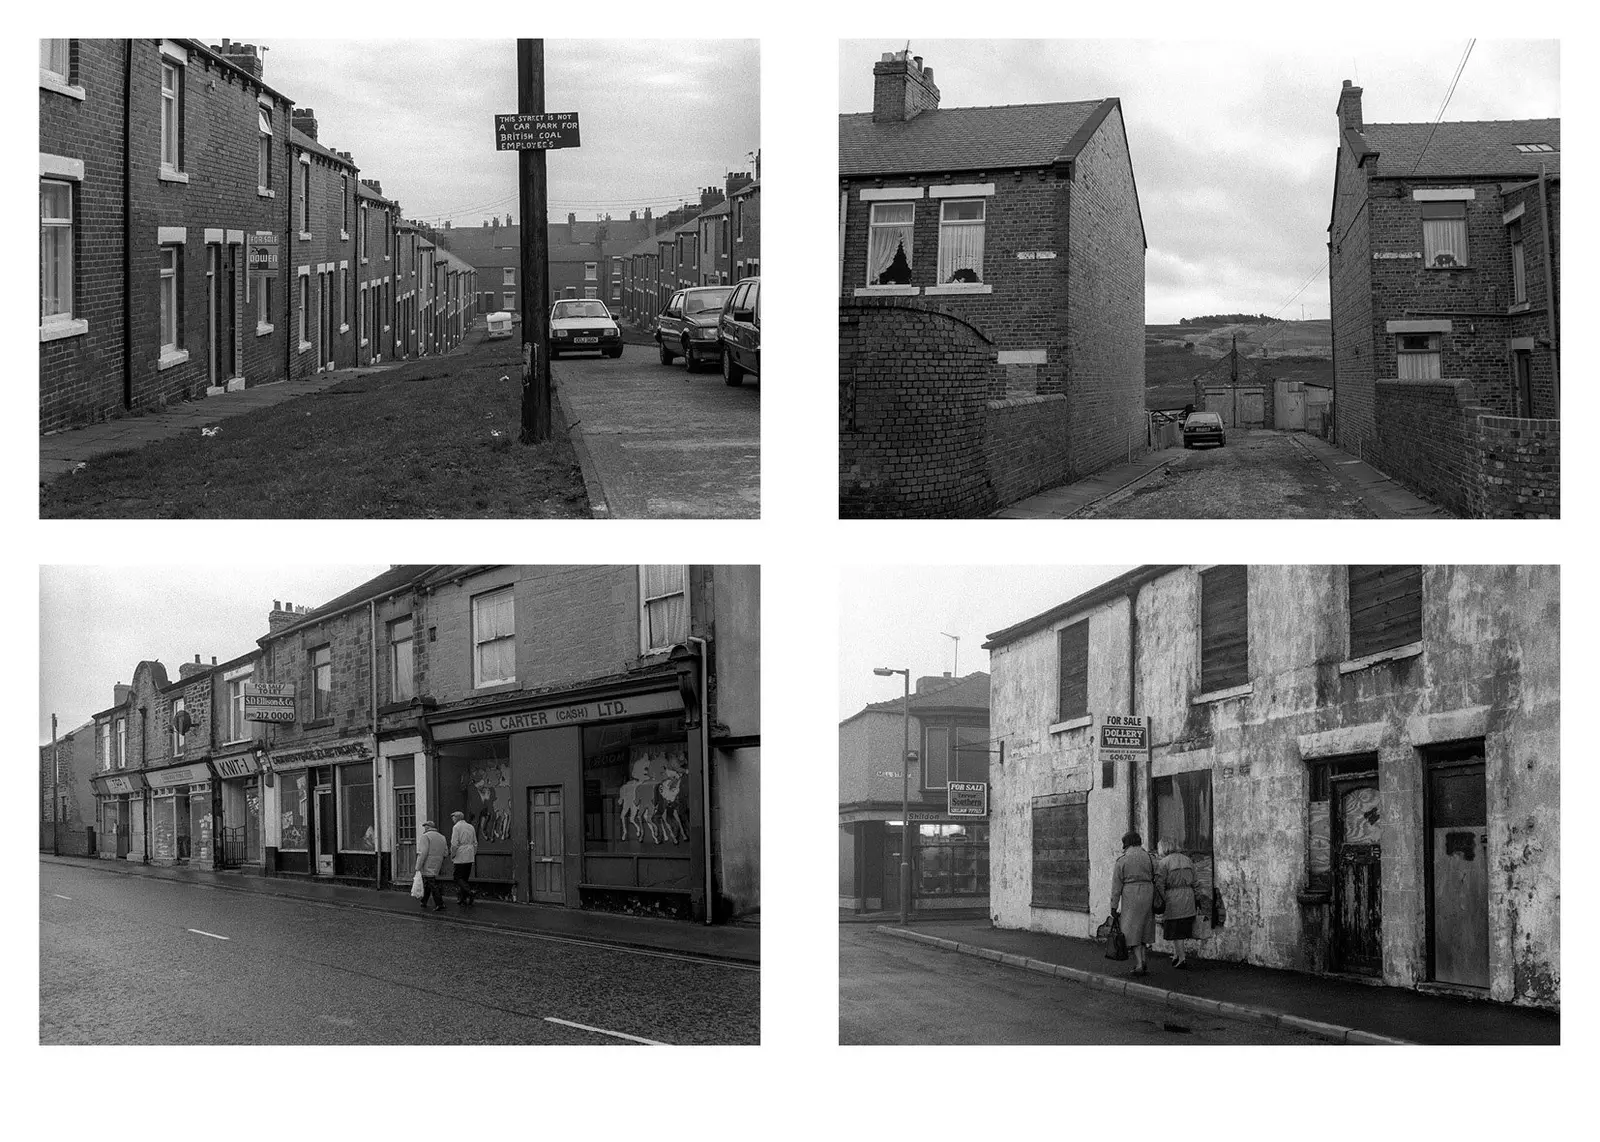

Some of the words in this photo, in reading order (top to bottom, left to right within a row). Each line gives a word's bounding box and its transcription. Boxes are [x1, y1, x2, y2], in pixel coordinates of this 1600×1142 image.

[500, 115, 515, 123] THIS
[513, 123, 530, 131] CAR
[536, 122, 558, 130] PARK
[500, 132, 533, 142] BRITISH
[256, 711, 269, 719] 212
[271, 711, 294, 720] 0000
[468, 719, 493, 734] GUS
[500, 711, 548, 730] CARTER
[555, 706, 588, 721] (CASH)
[1106, 715, 1121, 725] FOR
[1123, 716, 1142, 726] SALE
[1104, 729, 1143, 738] DOLLERY
[1106, 737, 1141, 746] WALLER
[908, 812, 940, 820] Shildon
